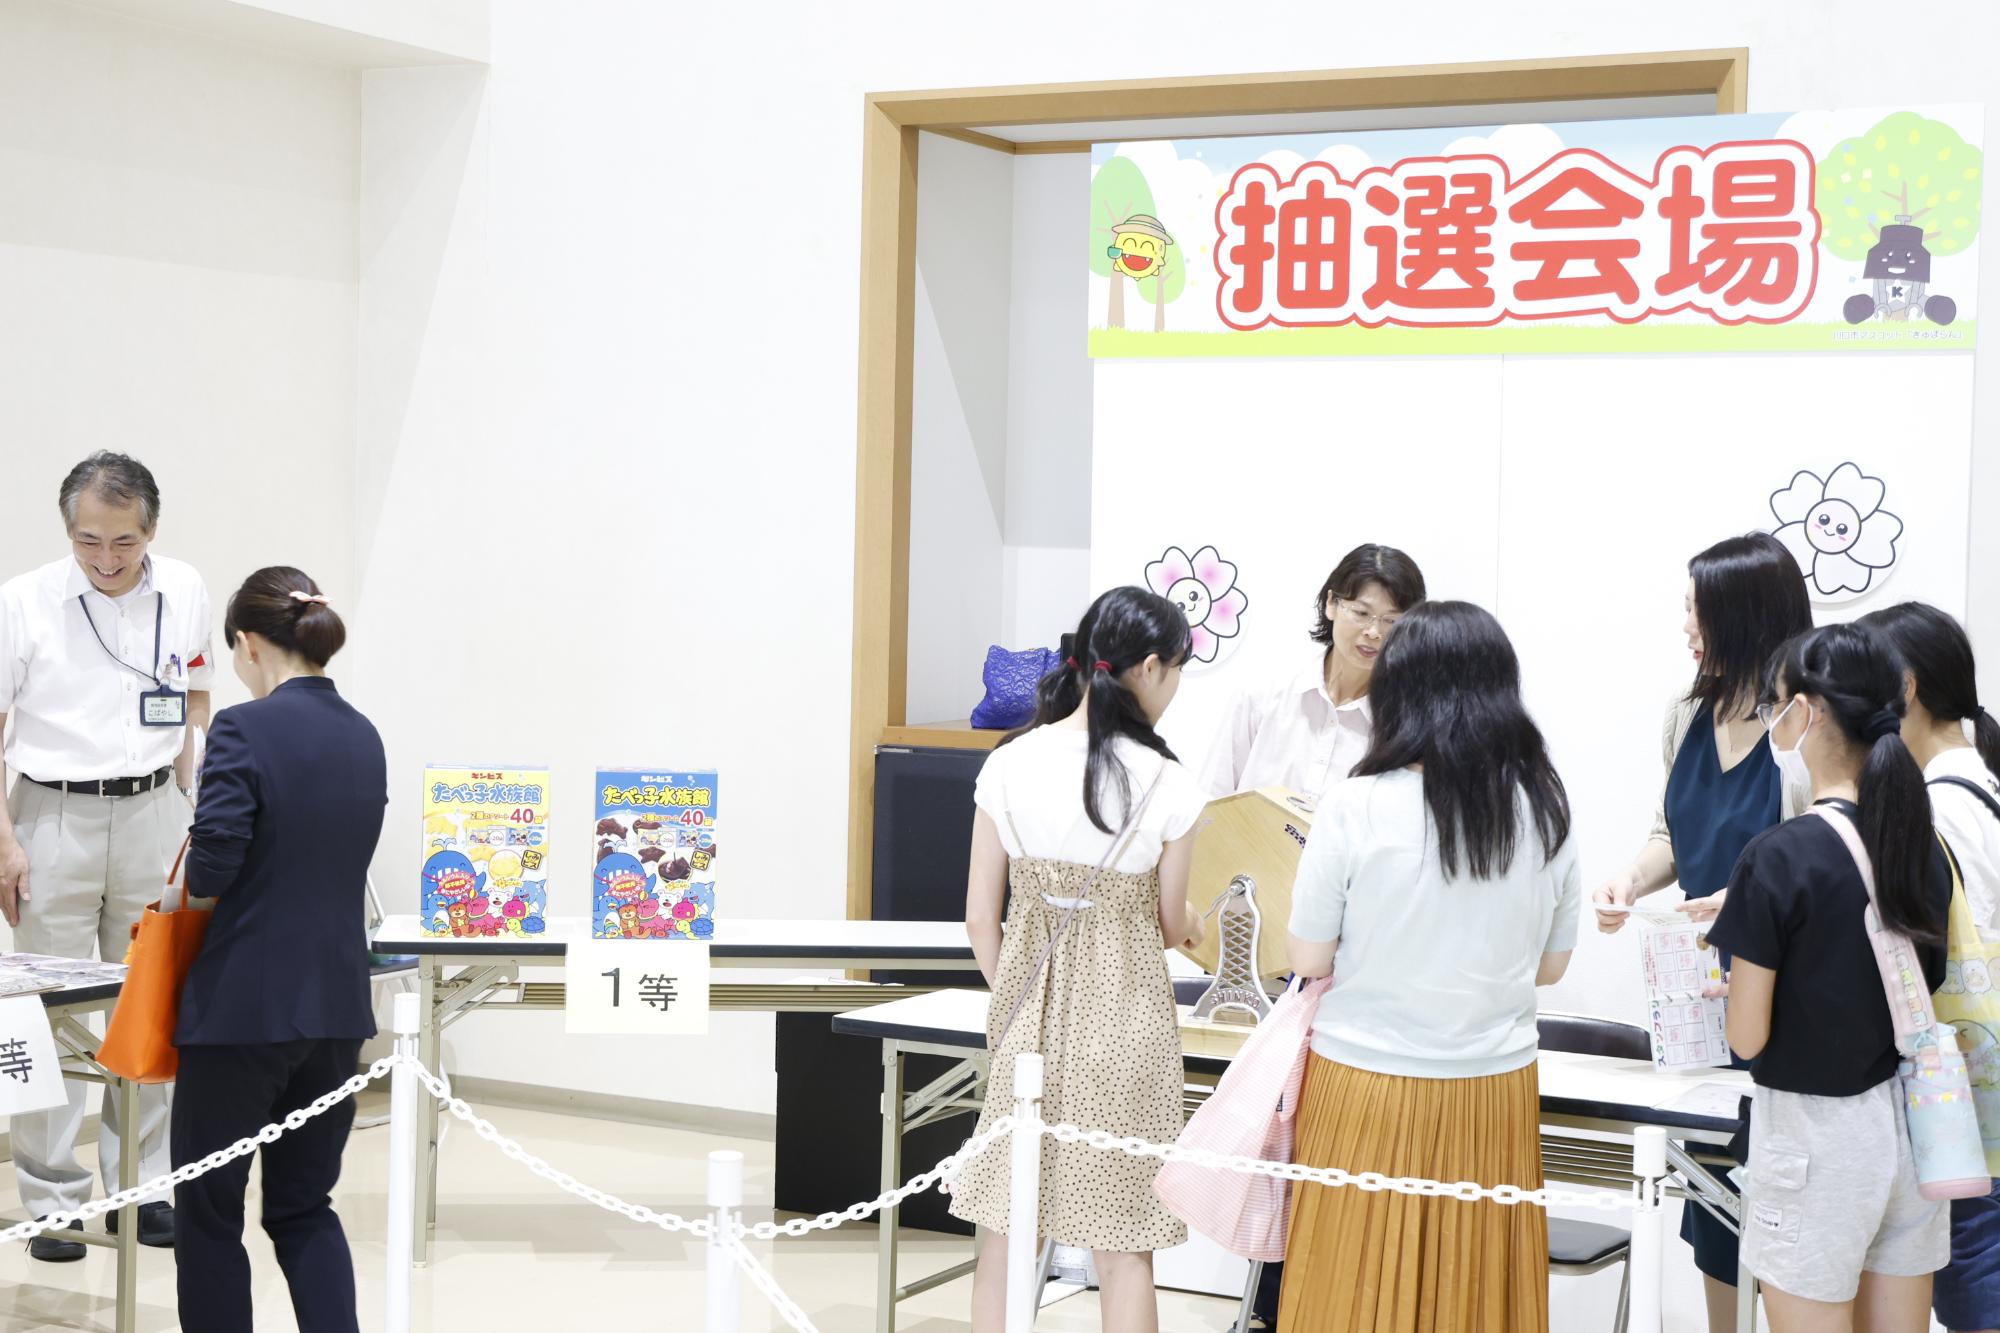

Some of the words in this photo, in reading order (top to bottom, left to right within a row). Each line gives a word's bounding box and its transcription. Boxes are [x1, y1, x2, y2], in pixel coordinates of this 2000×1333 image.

[1229, 157, 1803, 311] 抽選会場
[1891, 286, 1904, 298] K
[431, 782, 542, 804] たべっ子水族館
[602, 785, 711, 807] たべっ子水族館
